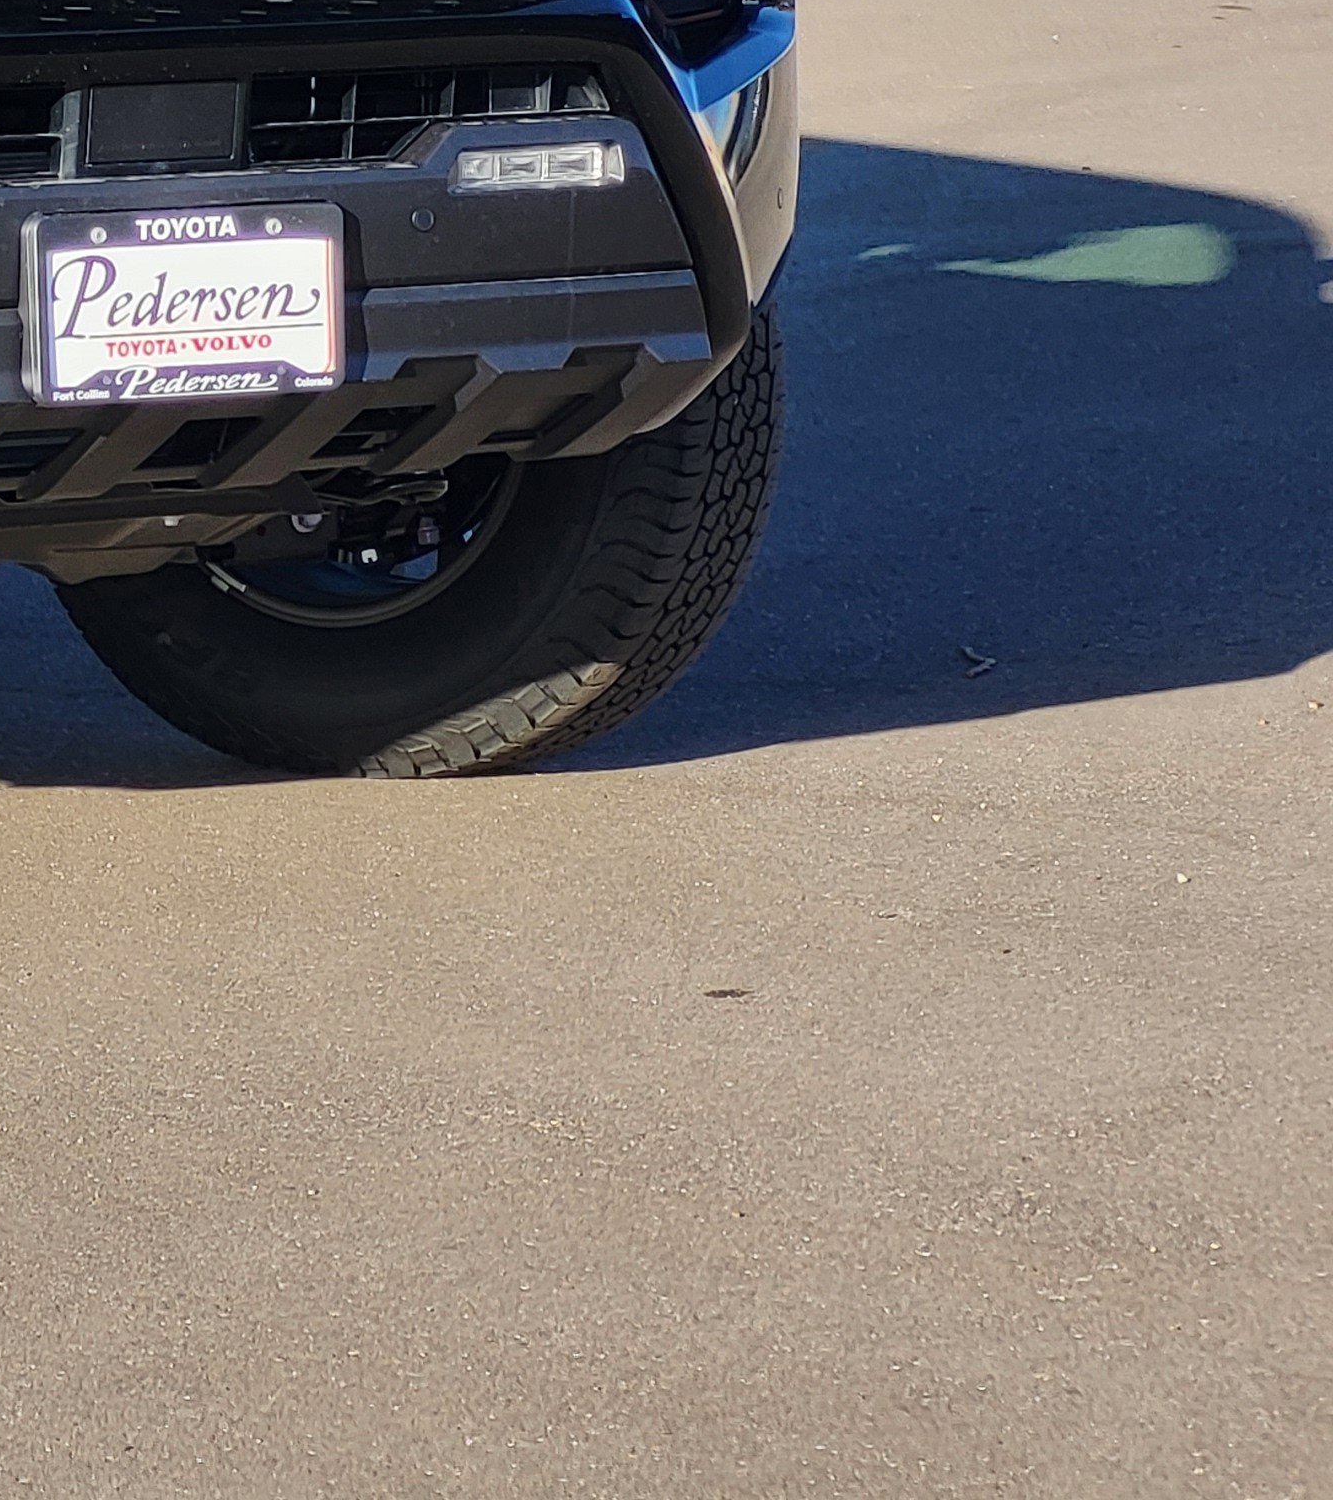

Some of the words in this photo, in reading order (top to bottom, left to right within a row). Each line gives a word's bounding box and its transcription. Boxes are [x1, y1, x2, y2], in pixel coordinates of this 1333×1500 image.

[135, 215, 237, 241] TOYOTA
[51, 255, 322, 340] Pedersen
[106, 340, 178, 358] TOYOTA
[192, 334, 273, 352] VOLVO
[114, 366, 278, 399] Pedersen
[53, 391, 75, 401] Fort
